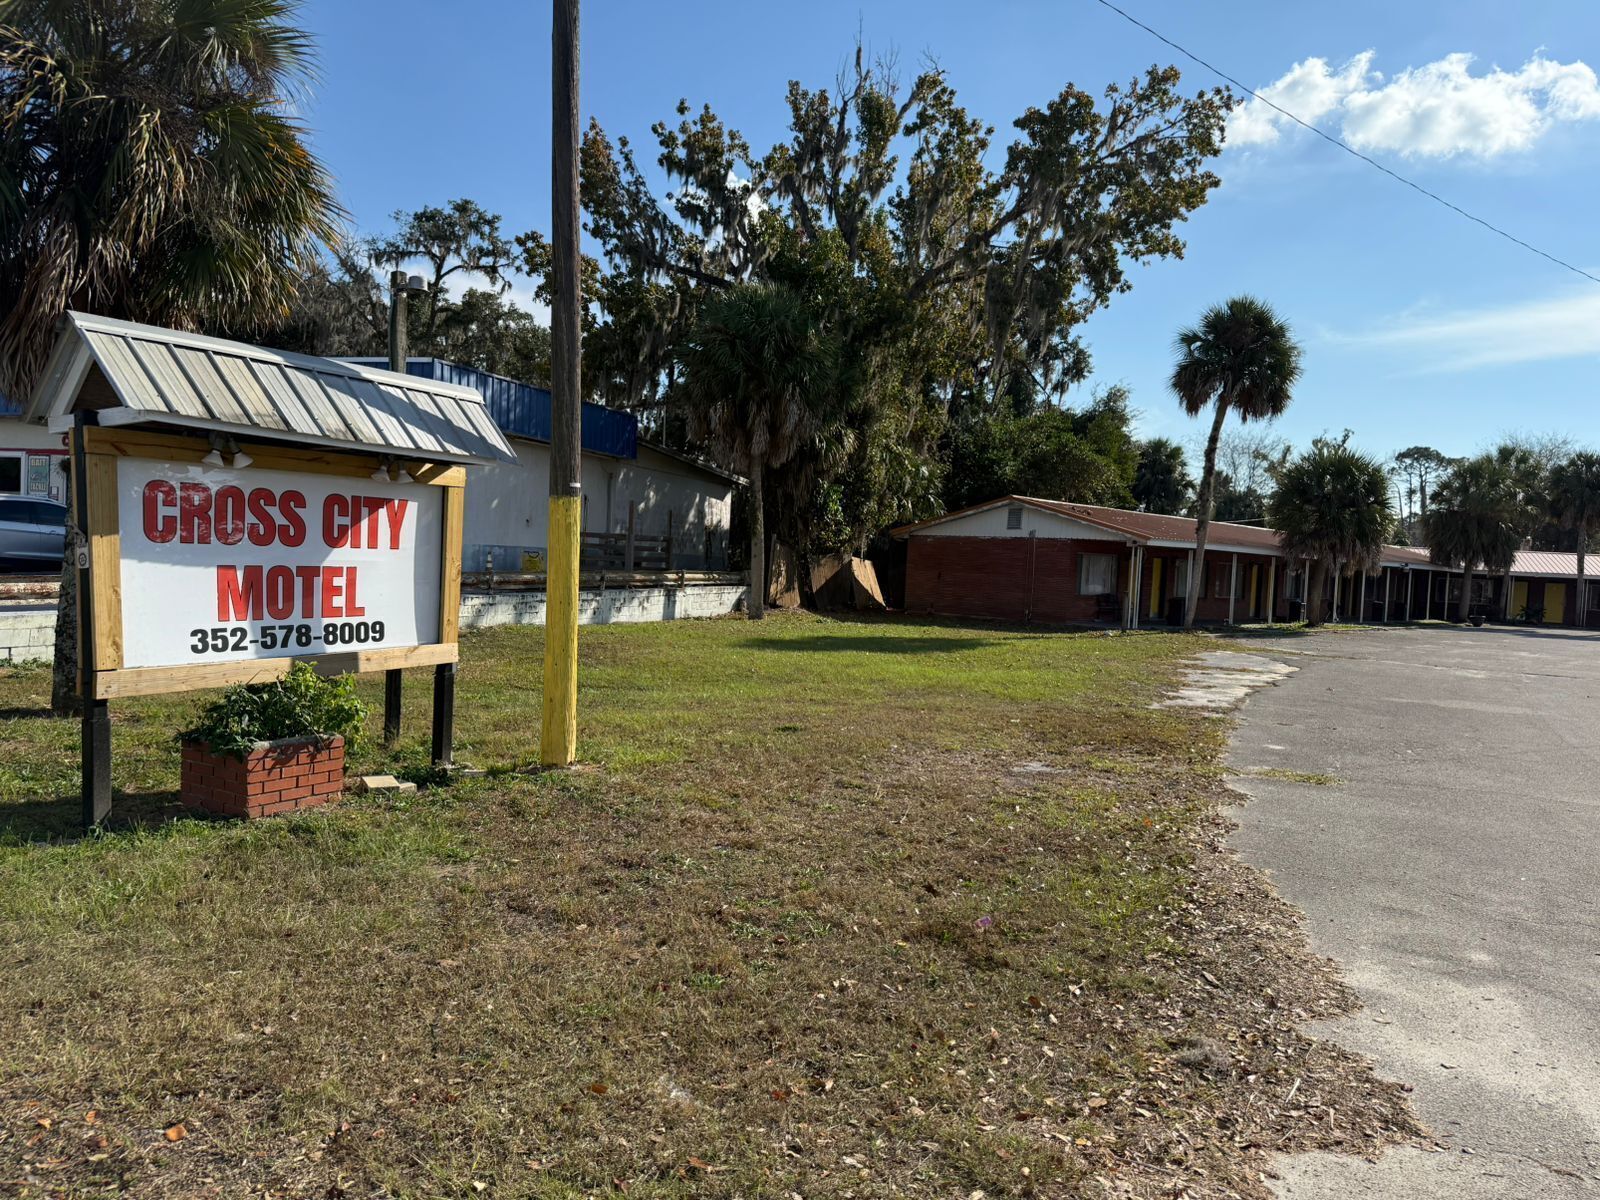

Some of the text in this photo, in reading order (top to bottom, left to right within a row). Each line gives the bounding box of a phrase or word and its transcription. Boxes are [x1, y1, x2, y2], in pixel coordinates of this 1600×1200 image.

[142, 479, 410, 550] CROSS CITY
[216, 564, 366, 622] MOTEL
[190, 620, 385, 654] 352-578-8009
